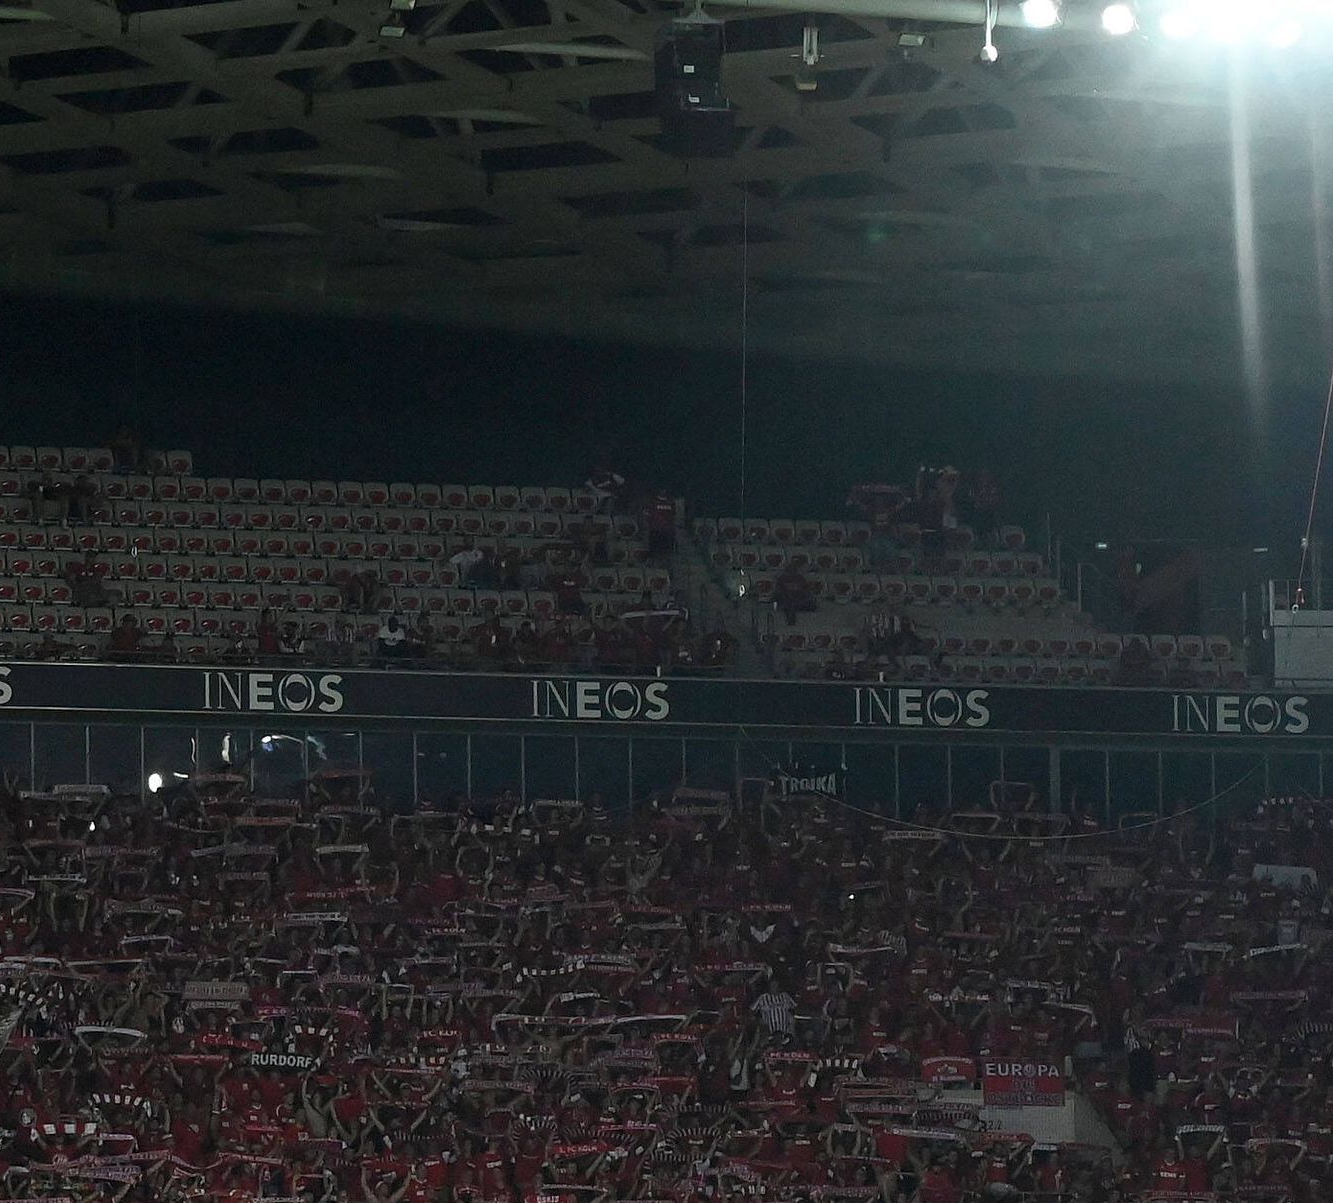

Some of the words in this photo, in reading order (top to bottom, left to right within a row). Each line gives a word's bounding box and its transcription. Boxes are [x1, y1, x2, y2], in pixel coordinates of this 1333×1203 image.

[202, 671, 345, 713] INEOS
[531, 679, 670, 721] INEOS
[852, 687, 990, 727] INEOS
[1171, 693, 1310, 735] INEOS
[251, 1053, 313, 1071] RURDORF
[985, 1062, 1060, 1078] EUROPA
